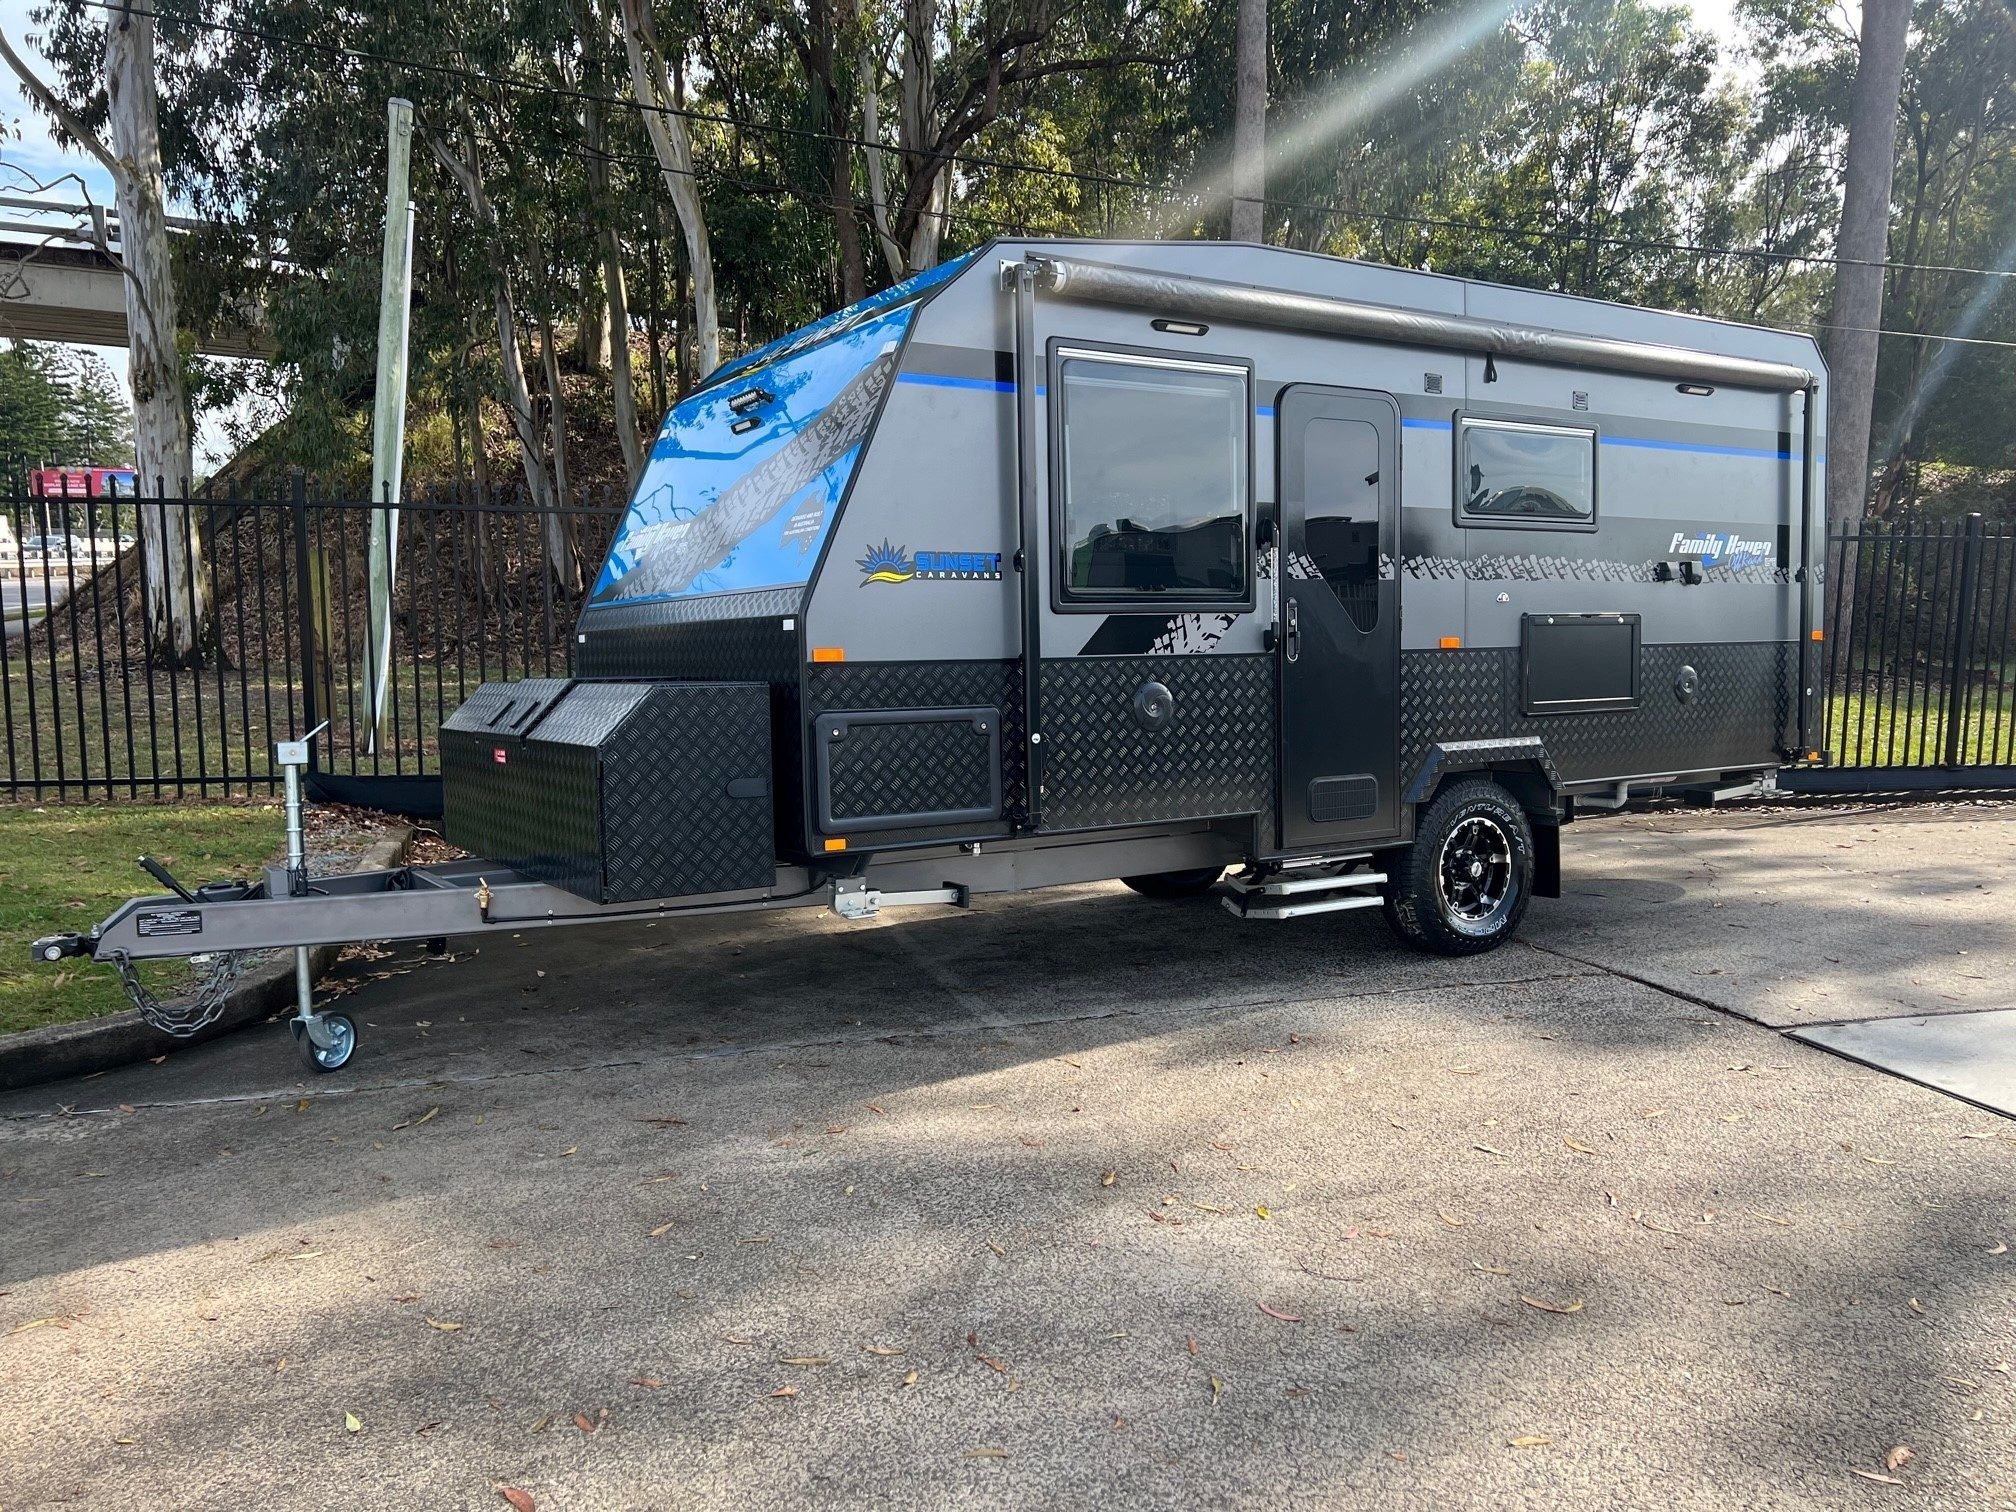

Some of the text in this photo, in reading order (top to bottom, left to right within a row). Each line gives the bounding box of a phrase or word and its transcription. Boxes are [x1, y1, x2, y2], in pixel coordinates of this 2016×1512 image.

[1669, 533, 1772, 559] Family Haven
[915, 552, 1001, 571] SUNSET
[916, 571, 1001, 579] CARAVANS
